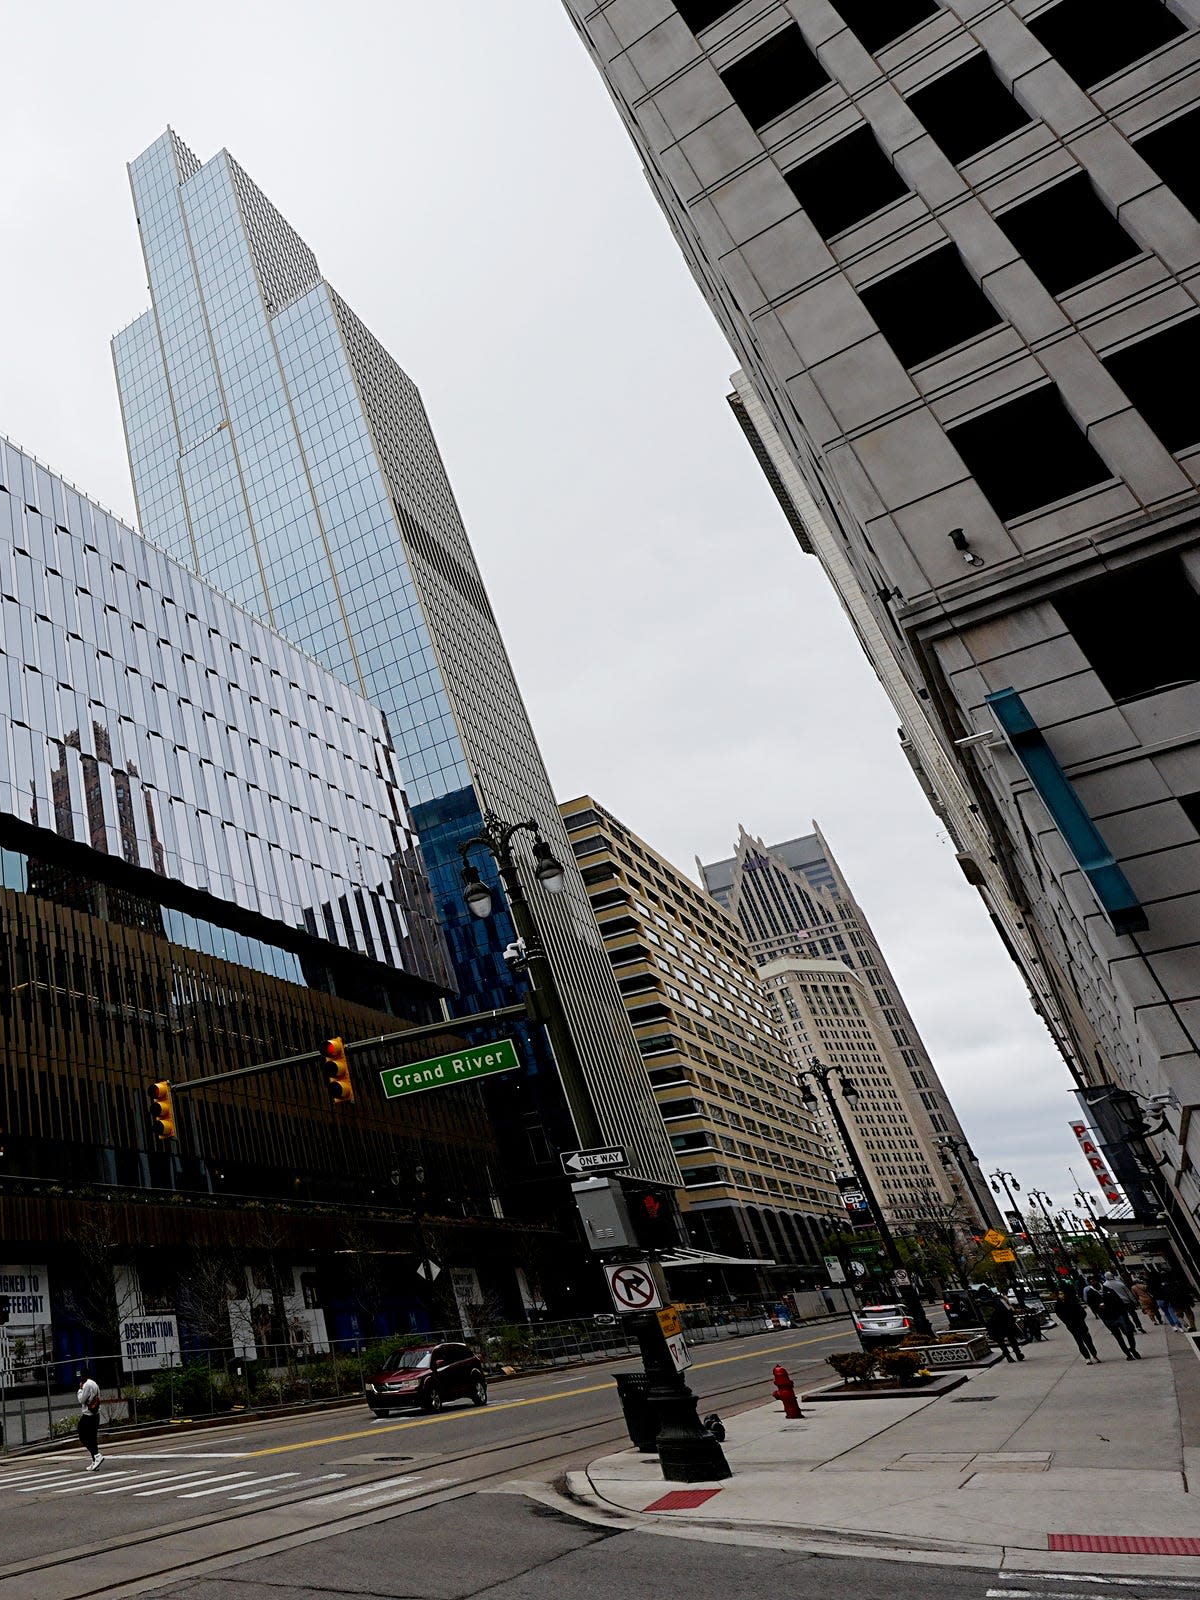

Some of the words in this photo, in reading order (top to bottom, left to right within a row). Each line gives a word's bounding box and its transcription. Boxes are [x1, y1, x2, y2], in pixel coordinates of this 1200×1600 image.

[392, 1065, 444, 1088] Grand
[452, 1051, 504, 1074] River
[580, 1156, 599, 1166] ONE
[600, 1153, 619, 1163] WAY
[1072, 1125, 1113, 1187] PARK
[844, 1194, 864, 1203] GP
[28, 1275, 39, 1292] TO
[125, 1321, 173, 1339] DESTINATION
[127, 1341, 157, 1359] DETROIT
